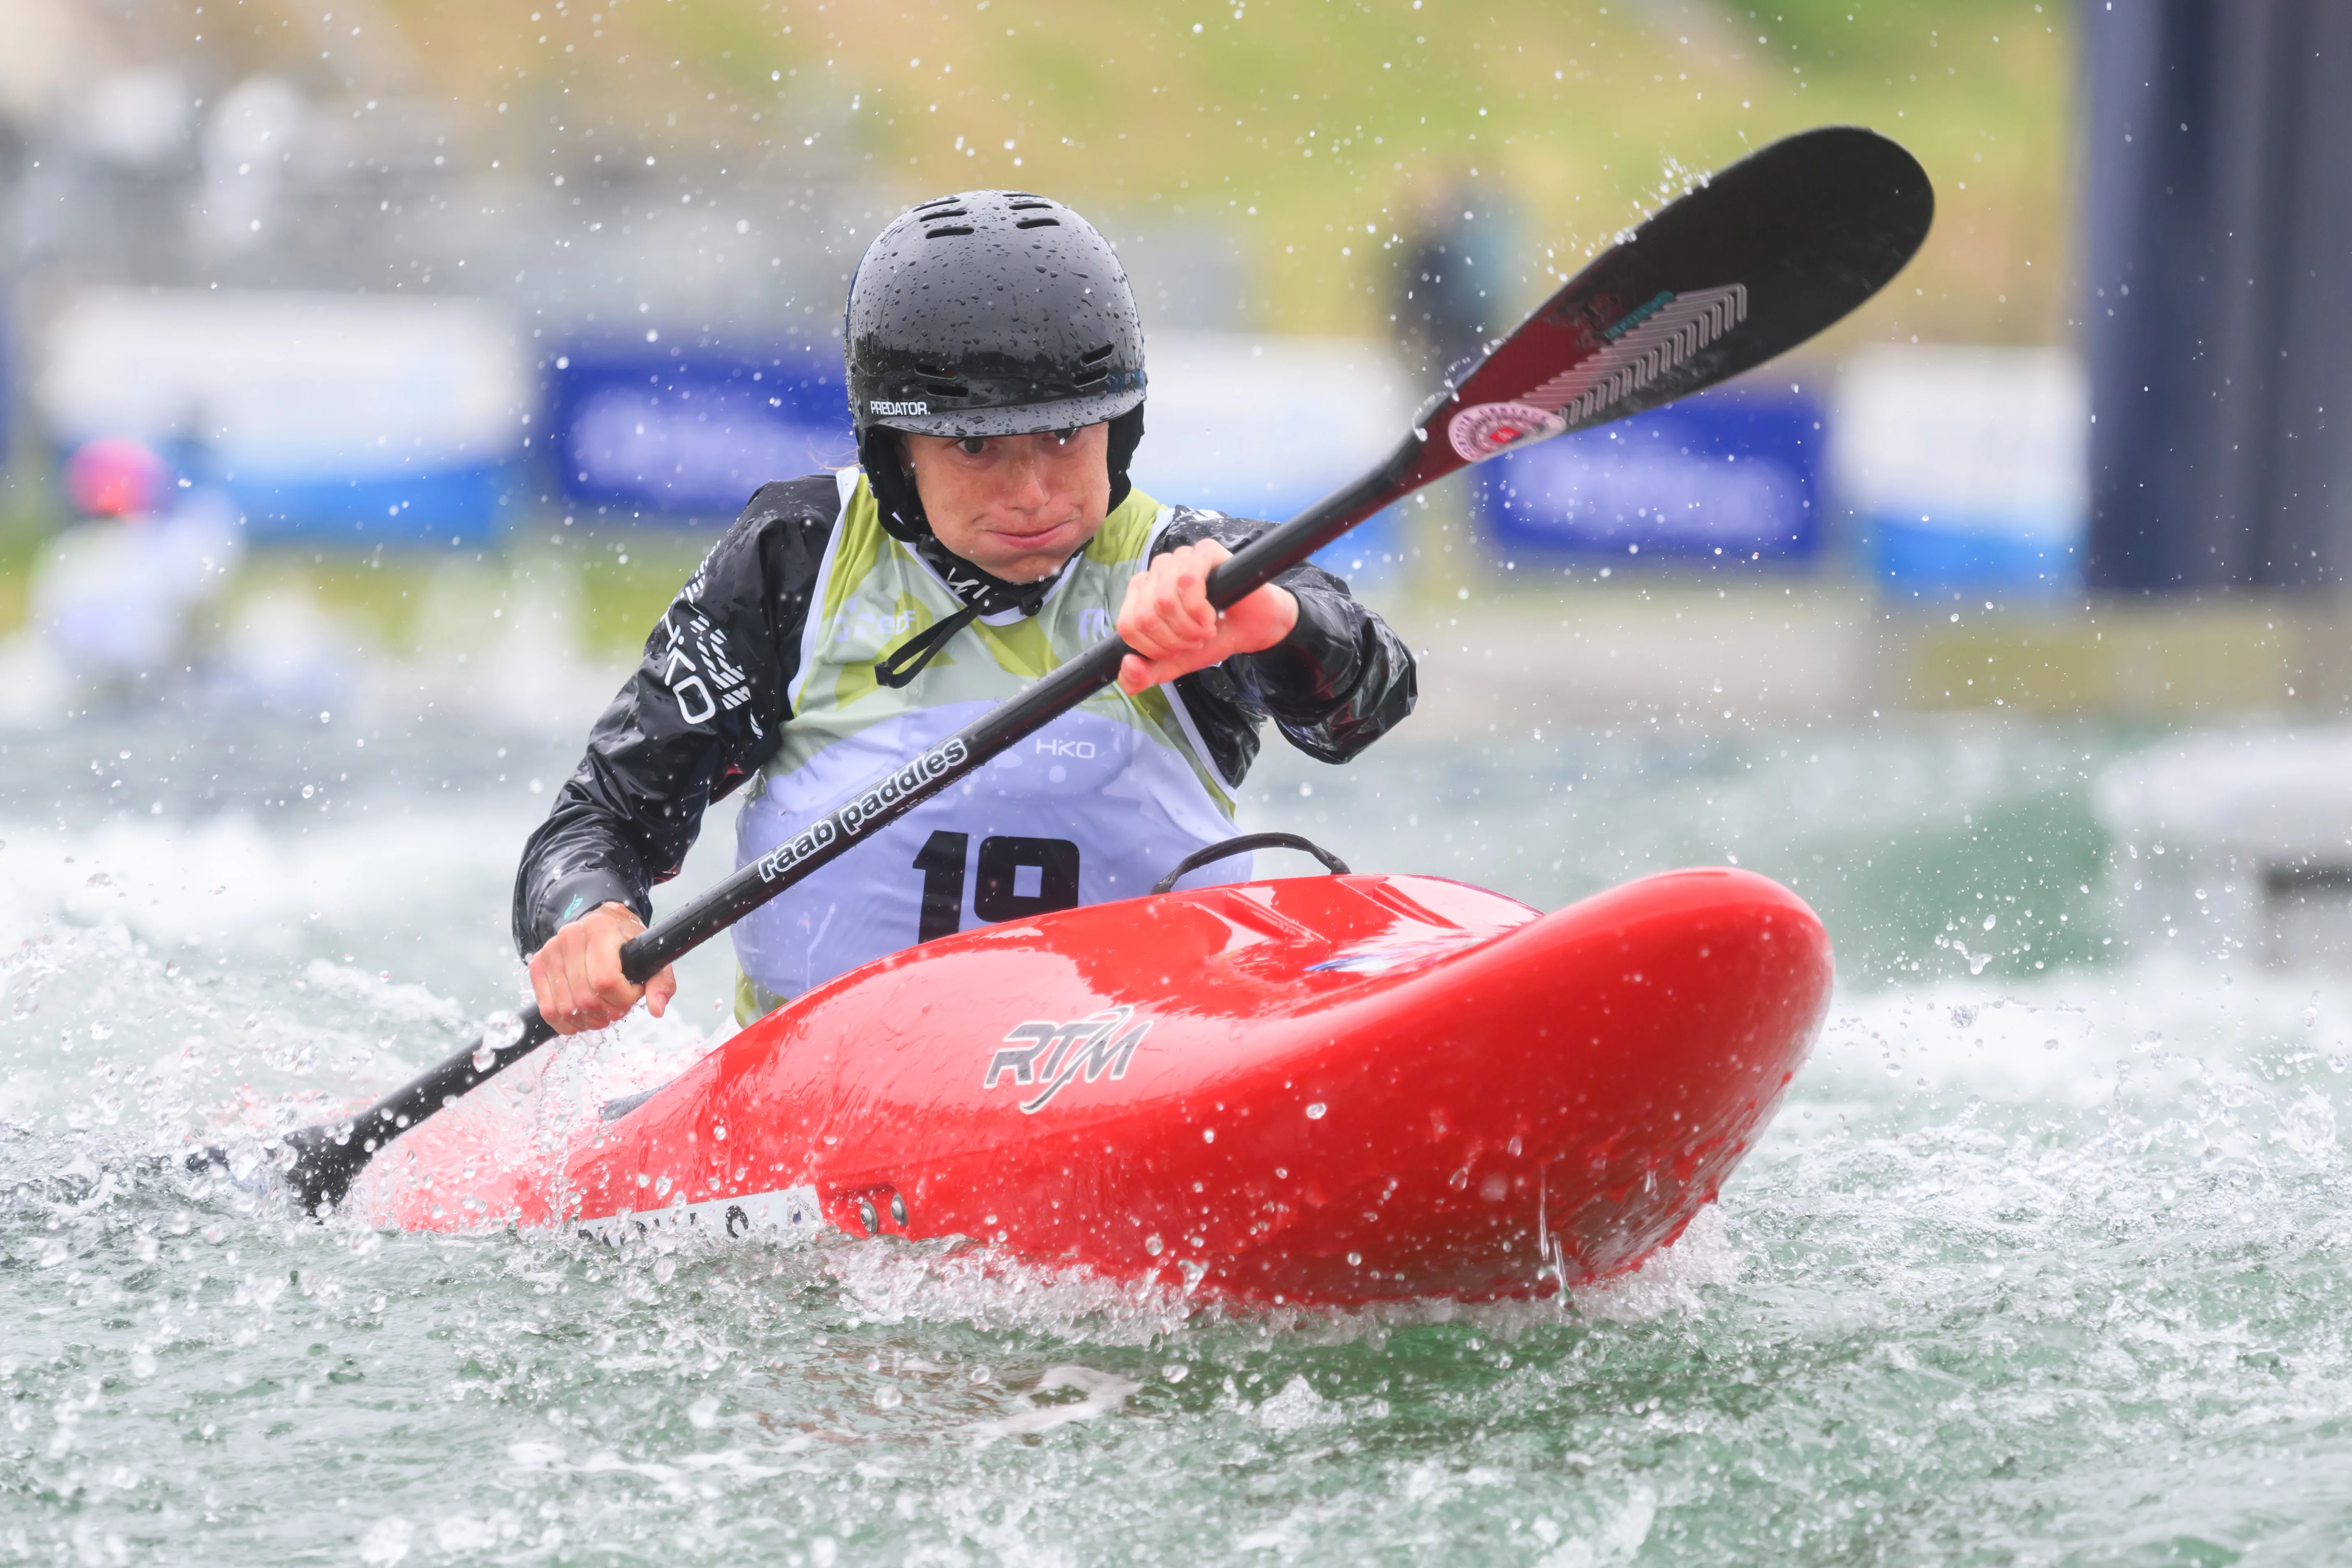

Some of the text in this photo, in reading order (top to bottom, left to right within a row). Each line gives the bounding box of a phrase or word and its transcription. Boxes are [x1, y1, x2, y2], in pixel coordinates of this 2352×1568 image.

[870, 401, 928, 415] PREDATOR
[758, 820, 836, 883] raab
[839, 738, 968, 836] paddles
[984, 1005, 1153, 1114] RTM
